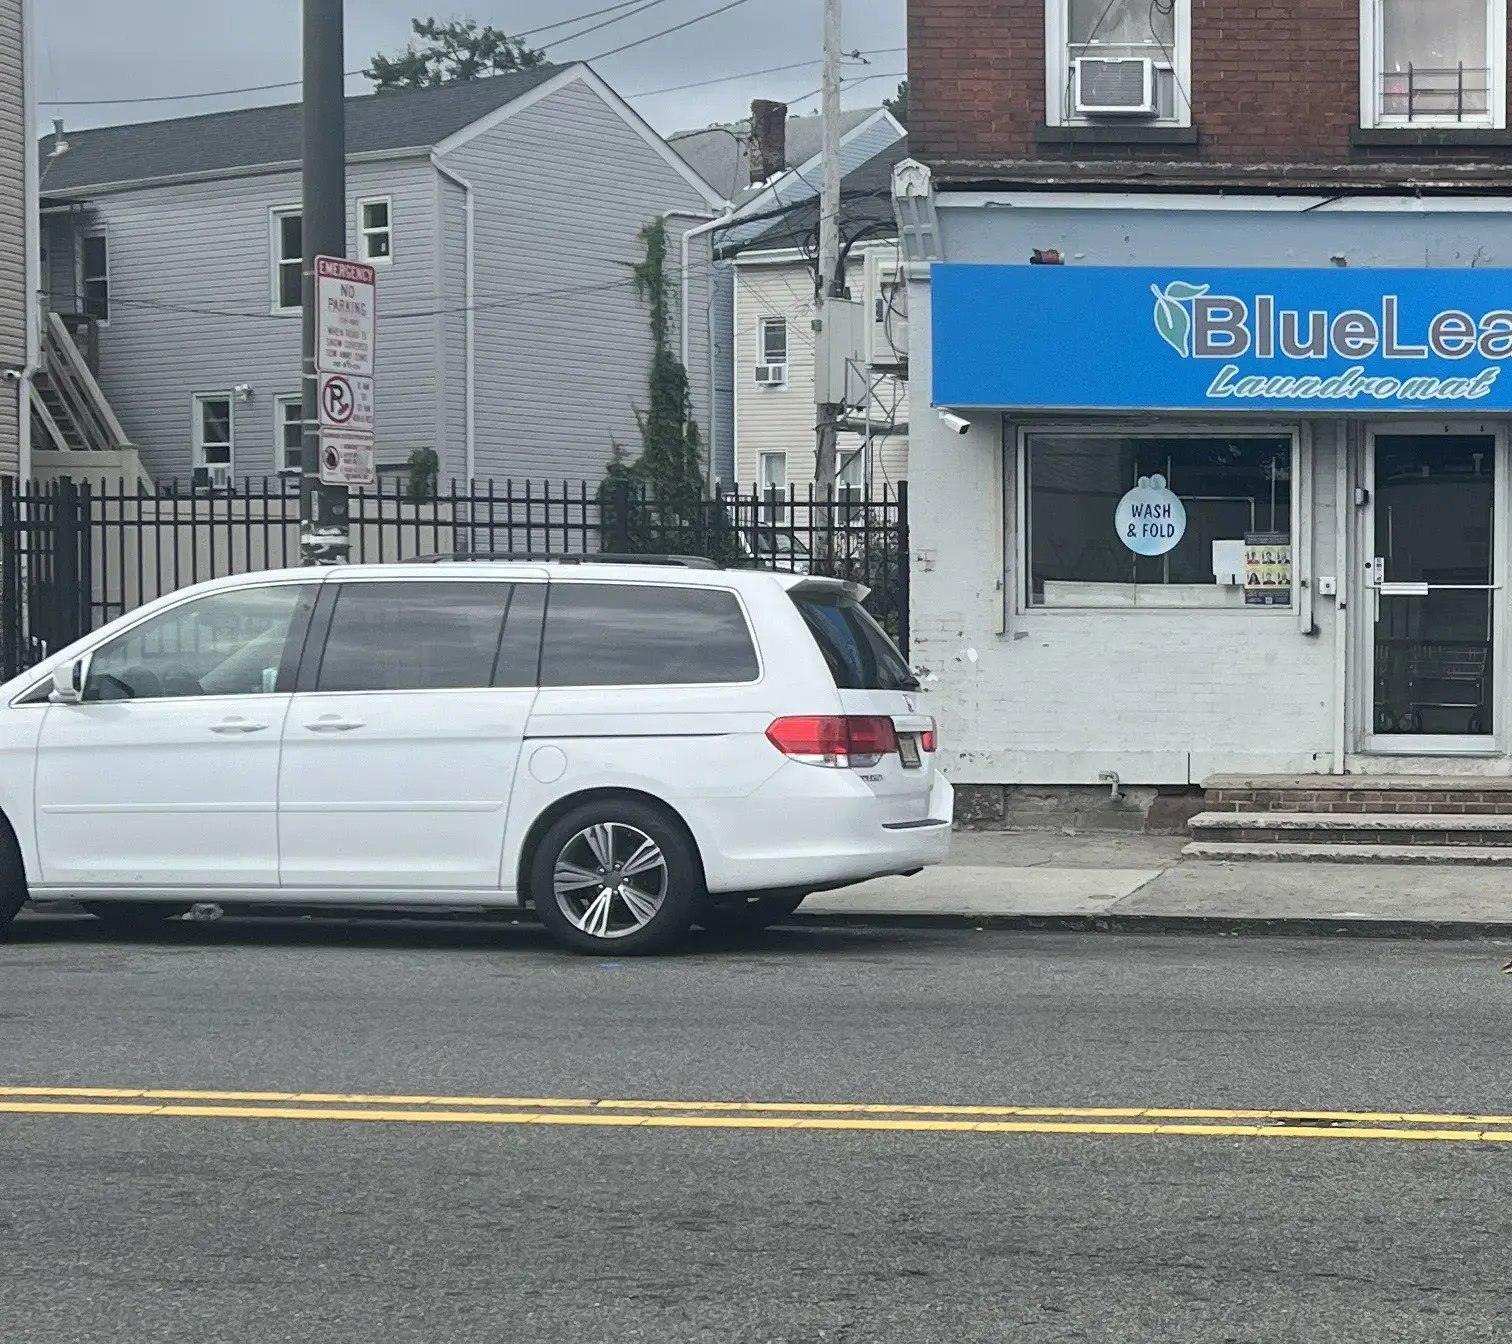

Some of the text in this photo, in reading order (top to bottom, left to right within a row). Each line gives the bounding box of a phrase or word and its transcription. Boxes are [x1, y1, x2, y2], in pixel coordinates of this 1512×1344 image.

[320, 260, 373, 283] EMERGENCY
[340, 284, 355, 299] NO
[328, 297, 367, 317] PARKING
[1206, 365, 1501, 400] Laundromat
[1132, 504, 1171, 518] WASH
[1127, 523, 1174, 538] & FOLD
